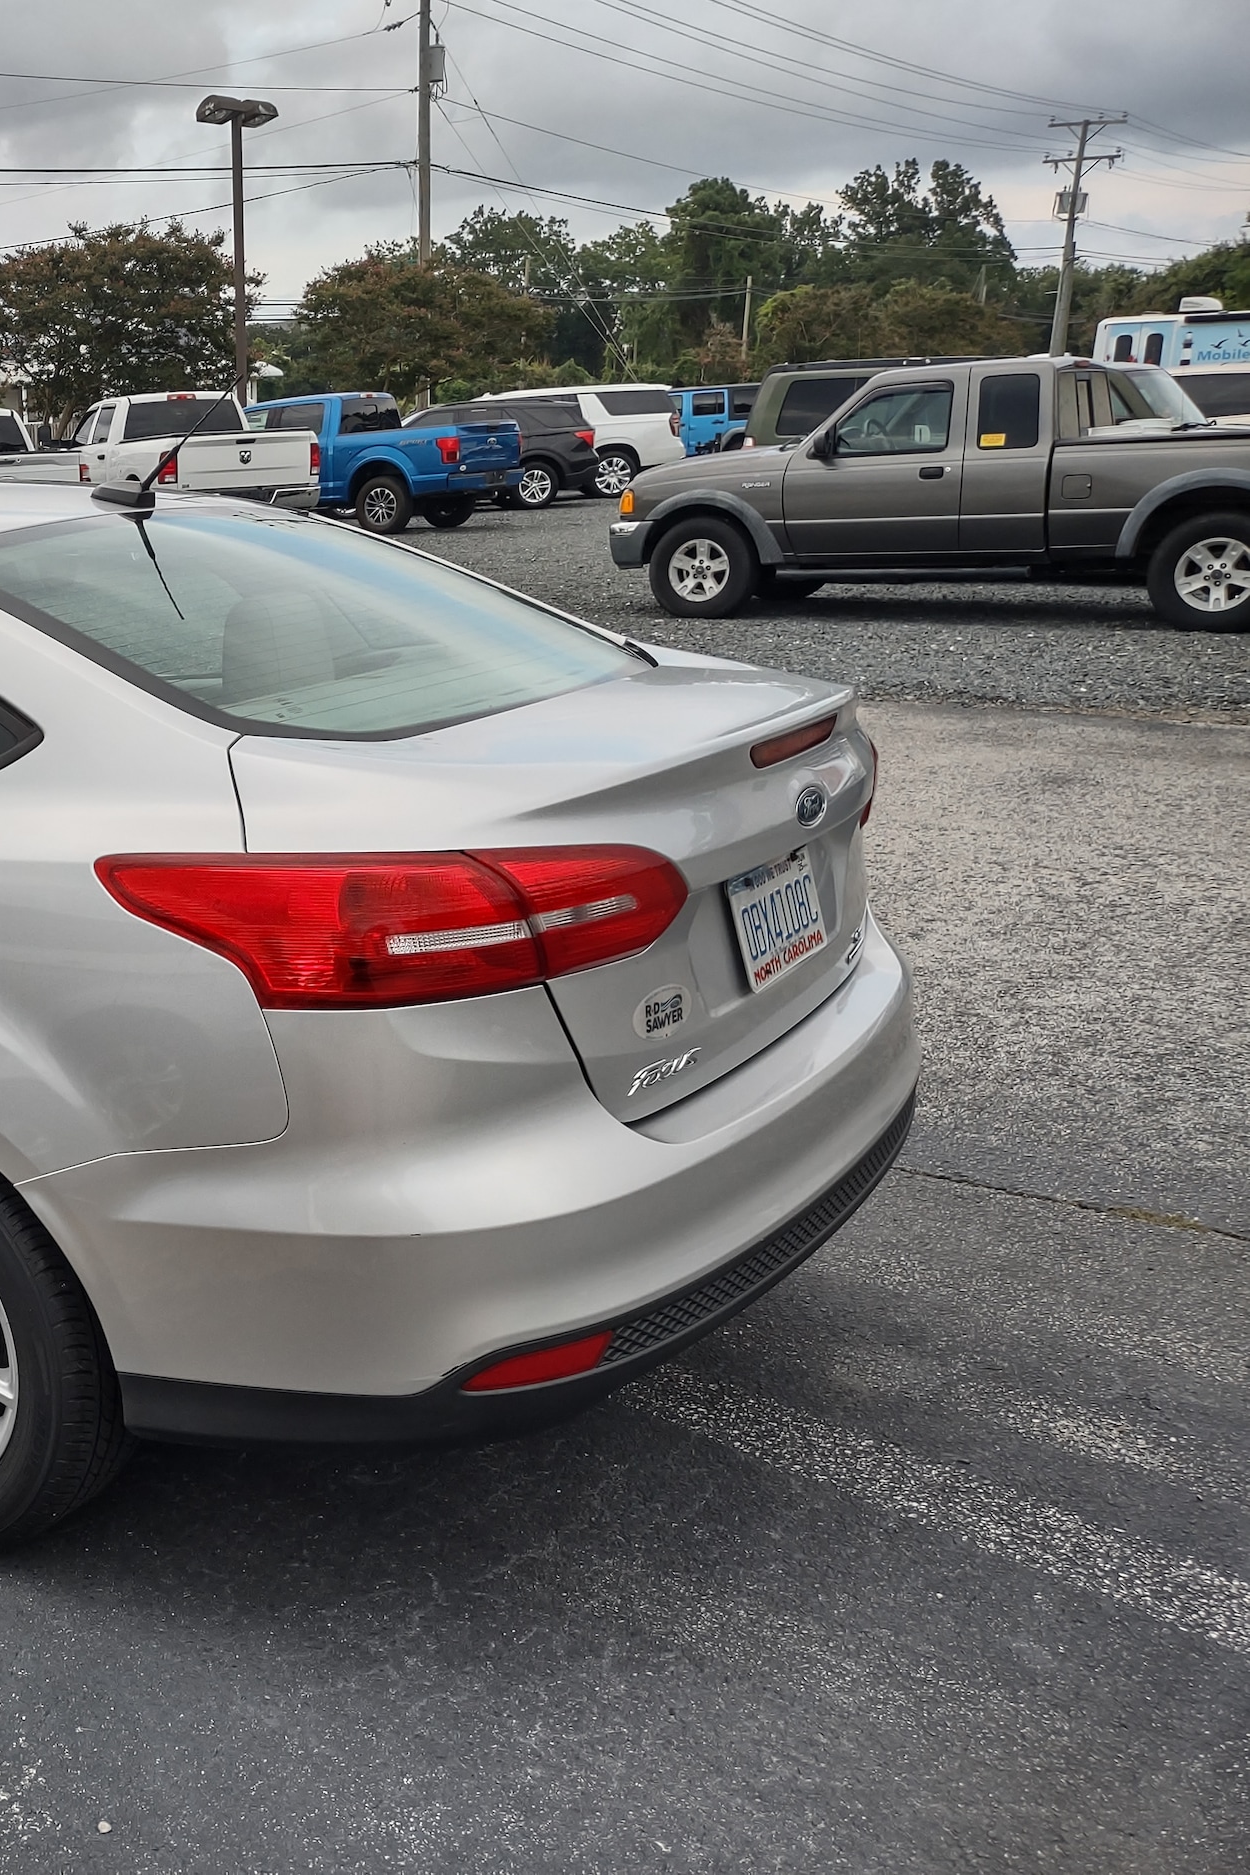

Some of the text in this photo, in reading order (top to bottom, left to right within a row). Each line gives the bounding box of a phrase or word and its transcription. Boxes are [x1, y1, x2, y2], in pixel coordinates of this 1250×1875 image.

[1197, 349, 1250, 361] Mobile
[753, 957, 782, 986] NORTH
[783, 929, 824, 965] CAROLINA
[646, 1007, 683, 1033] SAWYER
[627, 1047, 702, 1097] Focus
